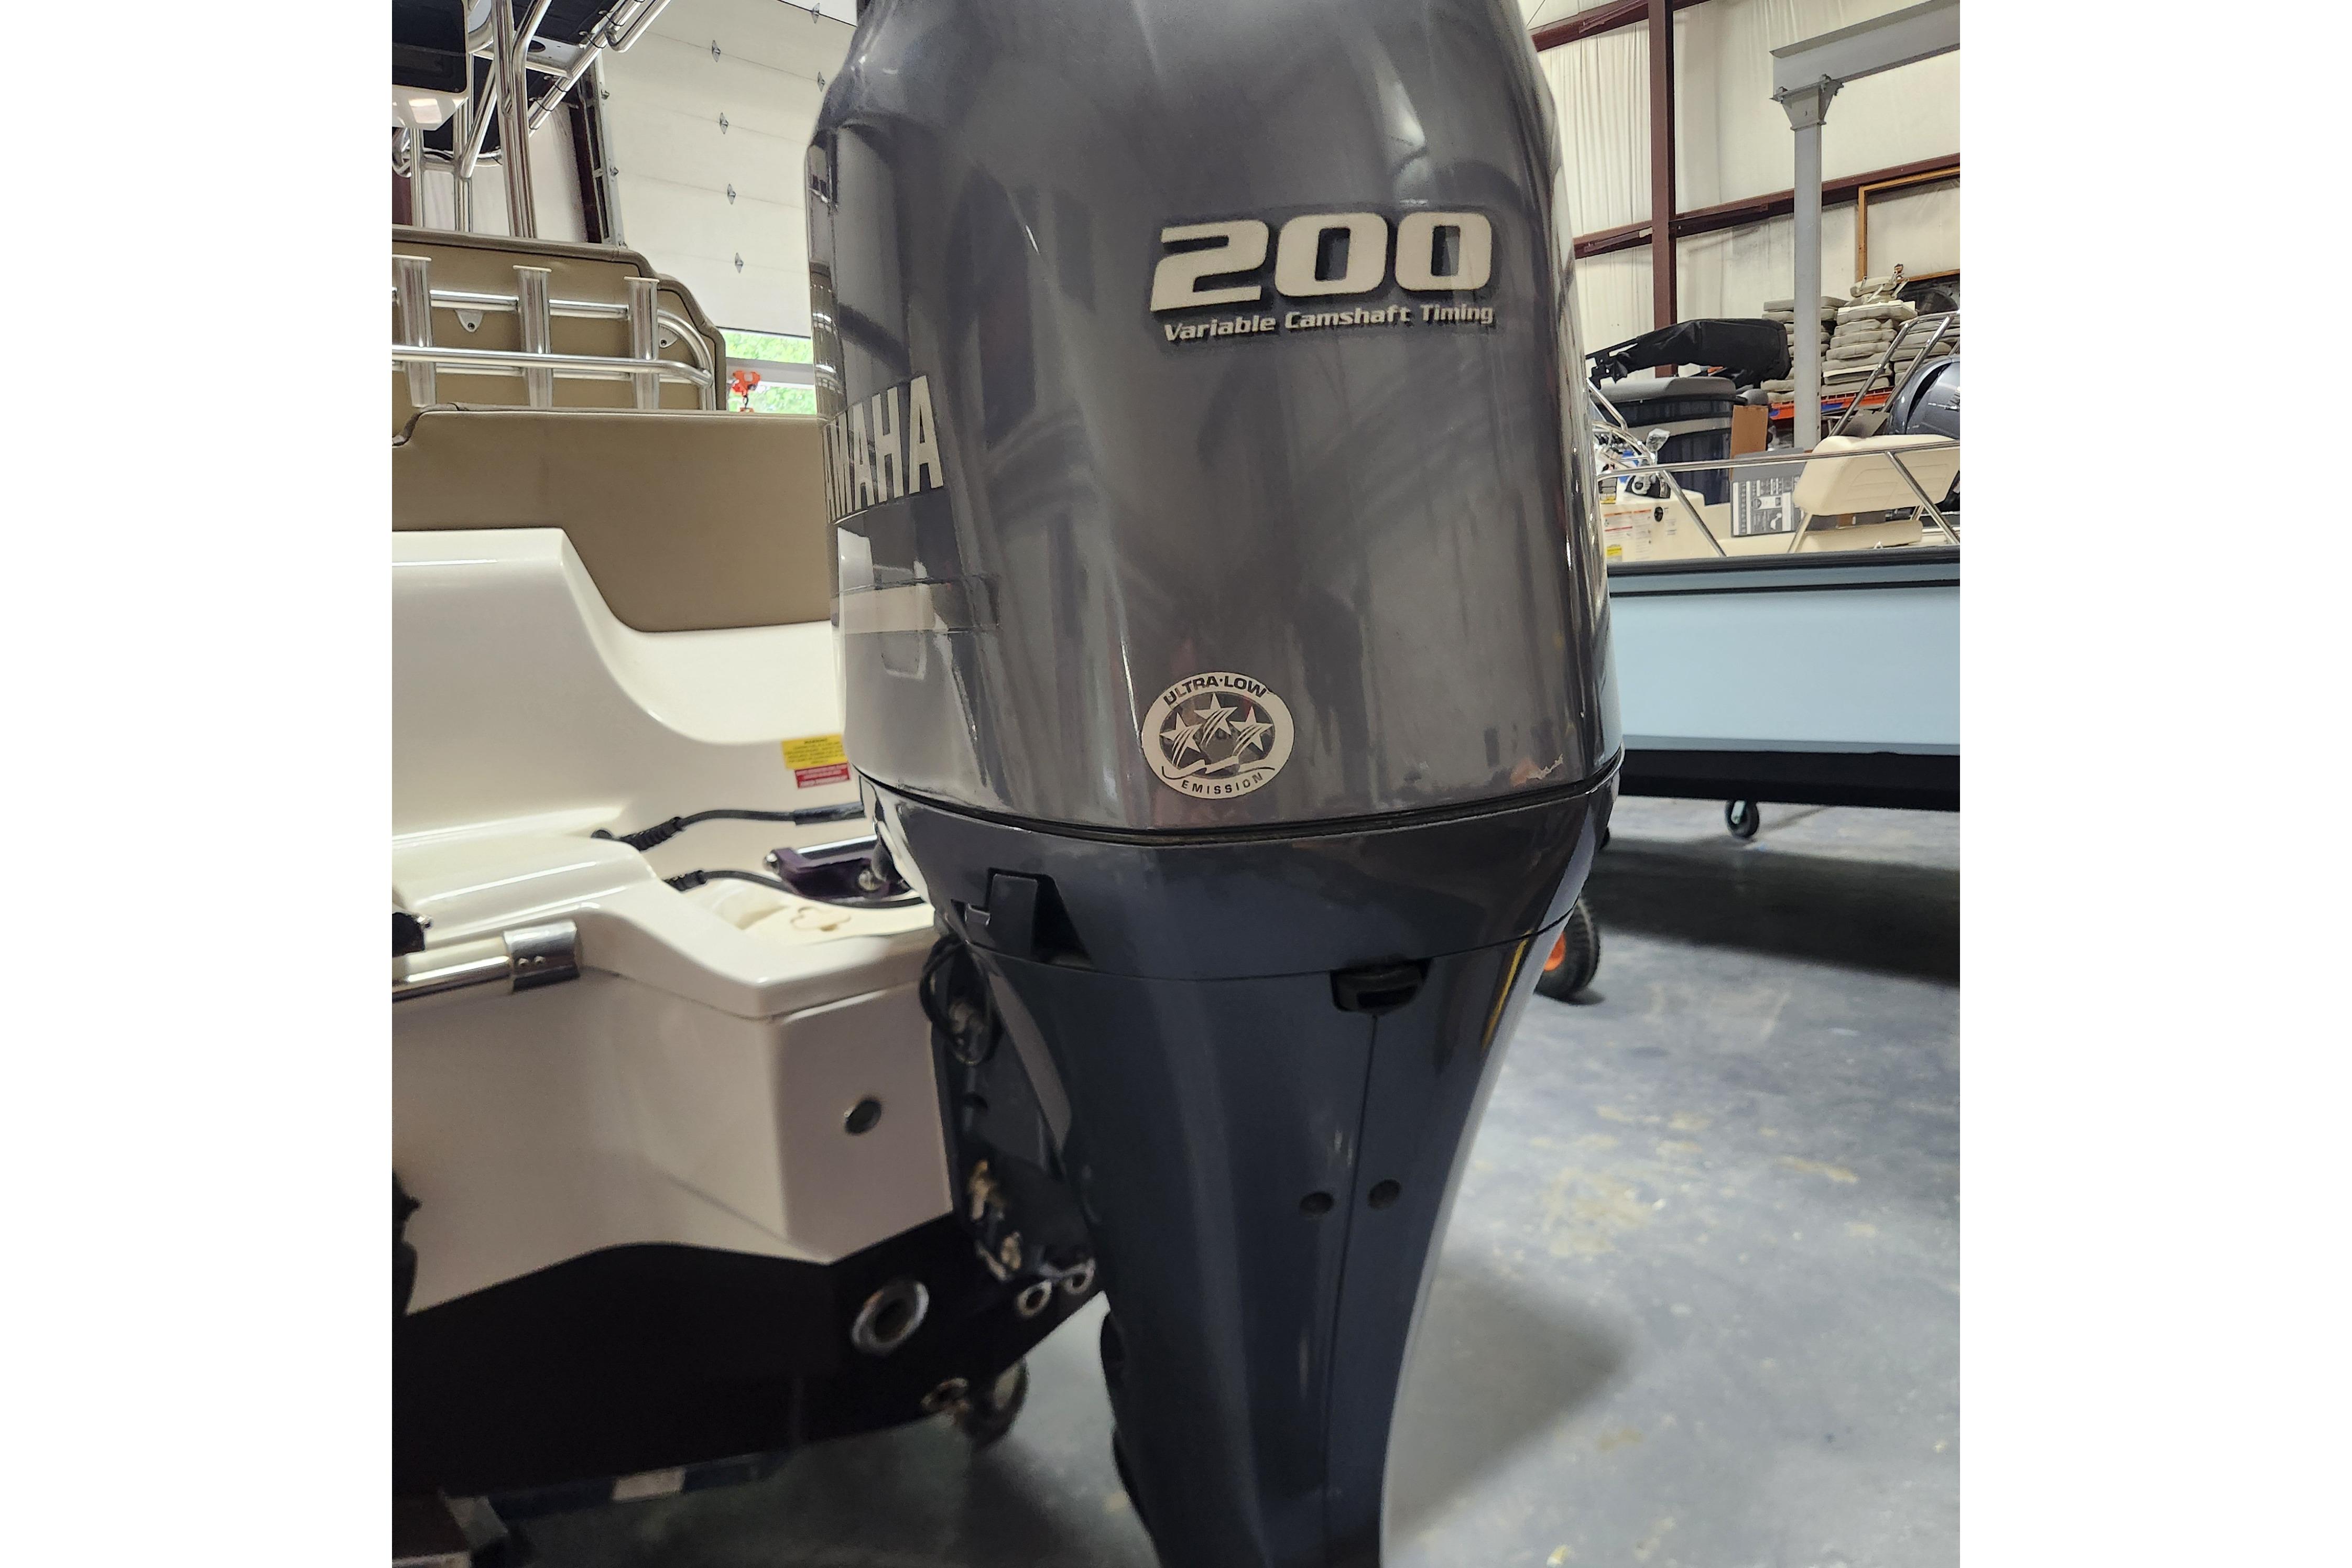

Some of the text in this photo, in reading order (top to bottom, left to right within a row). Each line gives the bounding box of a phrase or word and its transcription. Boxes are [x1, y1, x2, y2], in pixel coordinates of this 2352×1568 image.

[1150, 212, 1493, 312] 200
[1164, 303, 1494, 341] Variable Camshaft Timing
[1181, 772, 1264, 794] EMISSION
